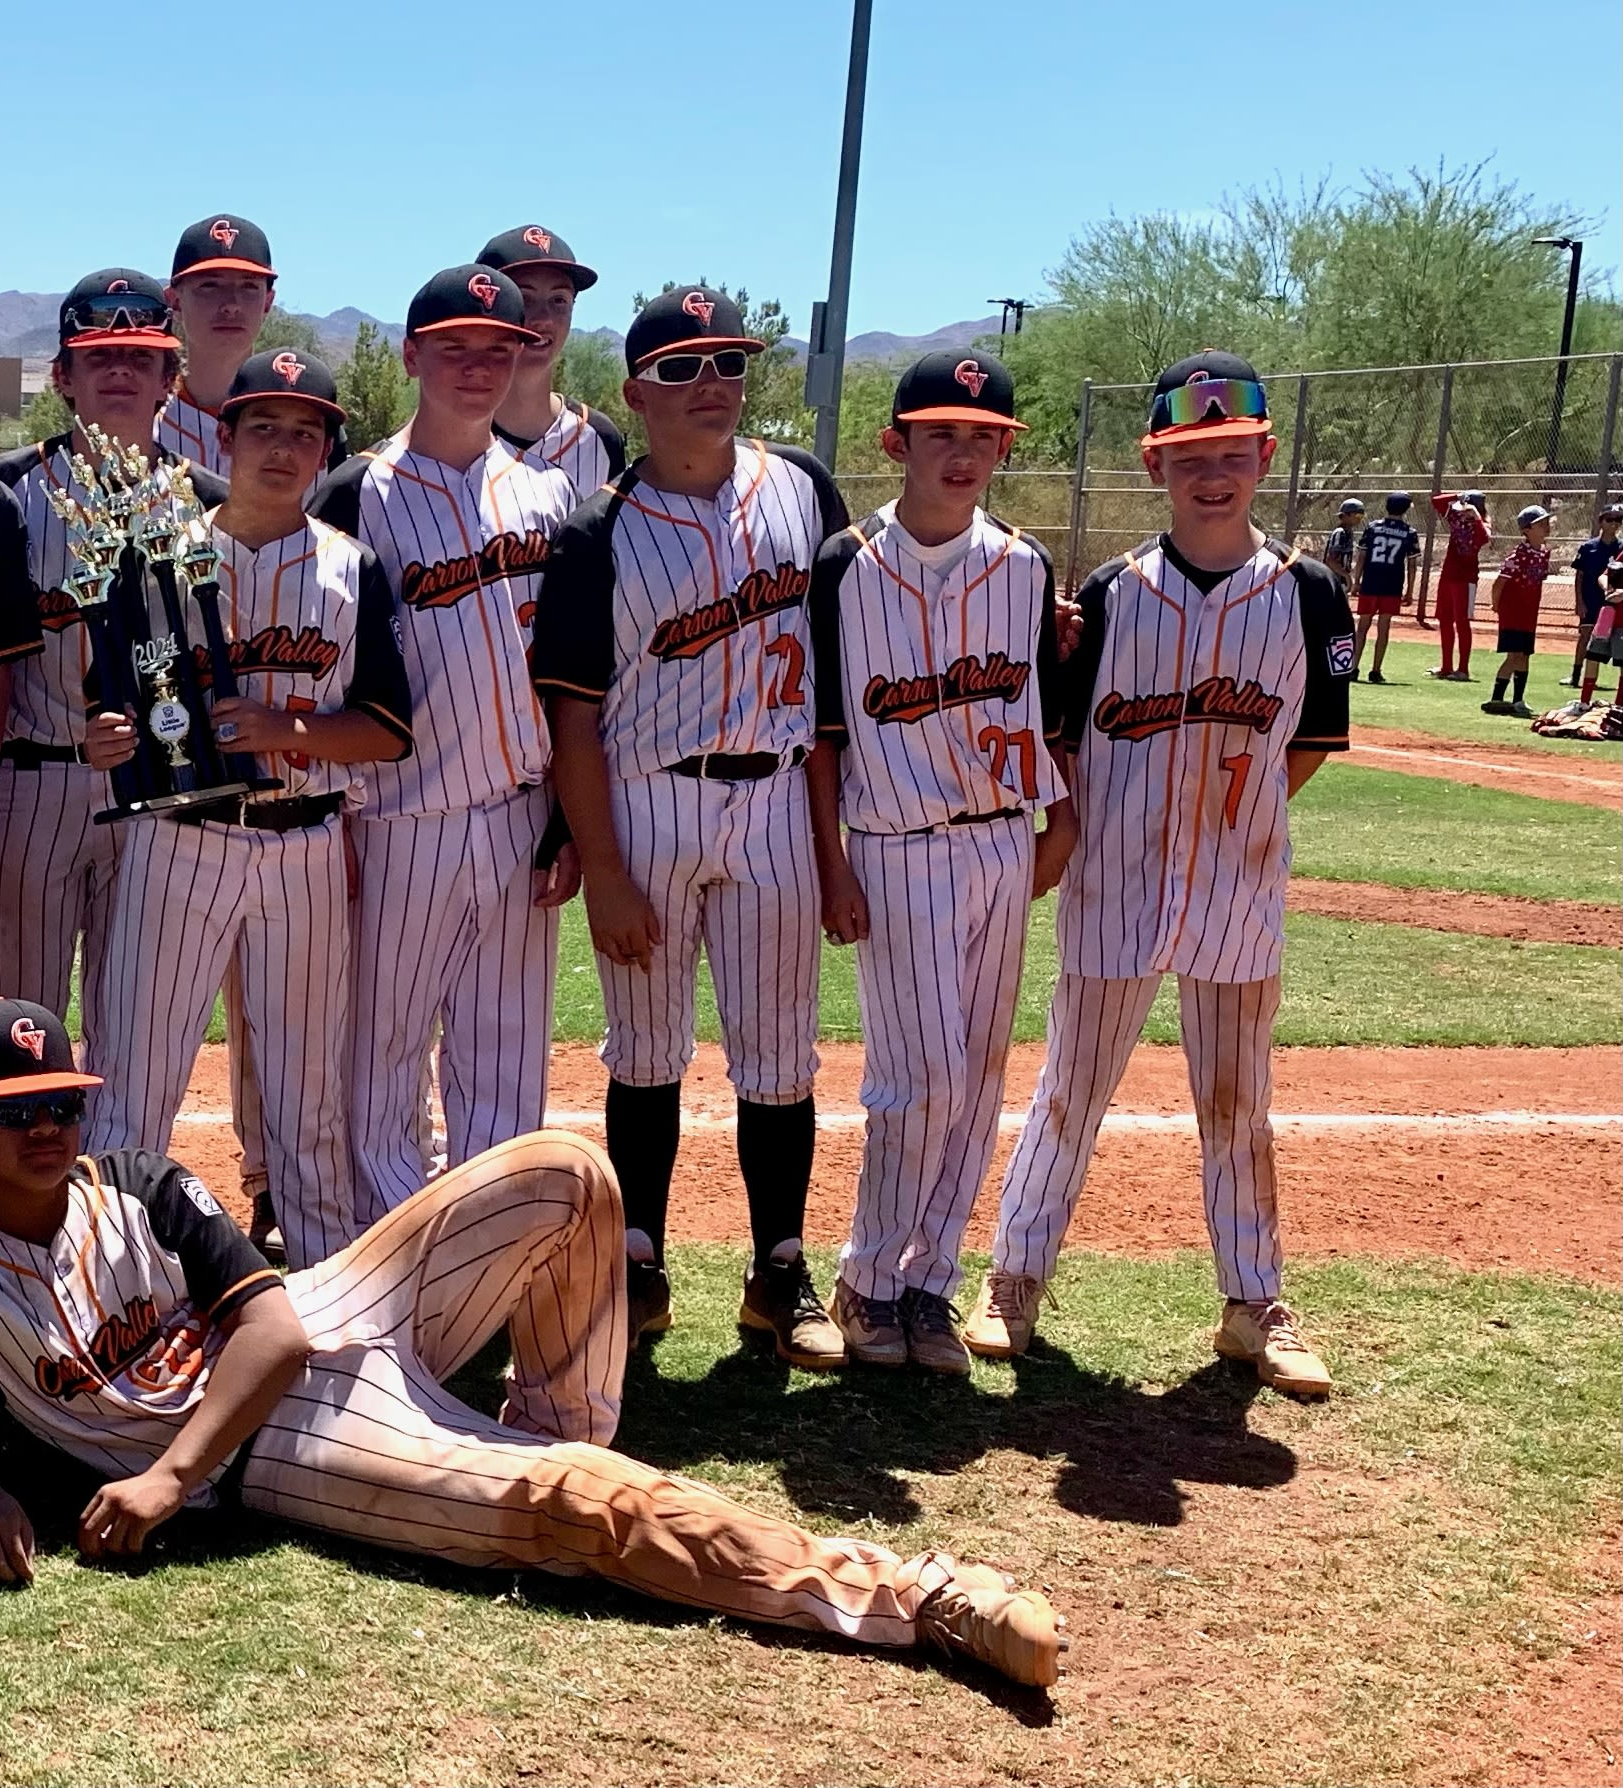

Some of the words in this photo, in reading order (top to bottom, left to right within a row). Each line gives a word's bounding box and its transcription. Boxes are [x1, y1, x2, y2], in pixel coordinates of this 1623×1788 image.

[1371, 536, 1402, 564] 27
[402, 552, 481, 604] Carson
[135, 632, 181, 666] 2024
[649, 592, 737, 656] Carson
[250, 625, 340, 681] Valley
[948, 652, 1031, 704] Valley
[161, 718, 180, 727] Little
[1094, 691, 1185, 733] Carson
[1190, 676, 1284, 734] Valley
[1222, 753, 1253, 829] 1
